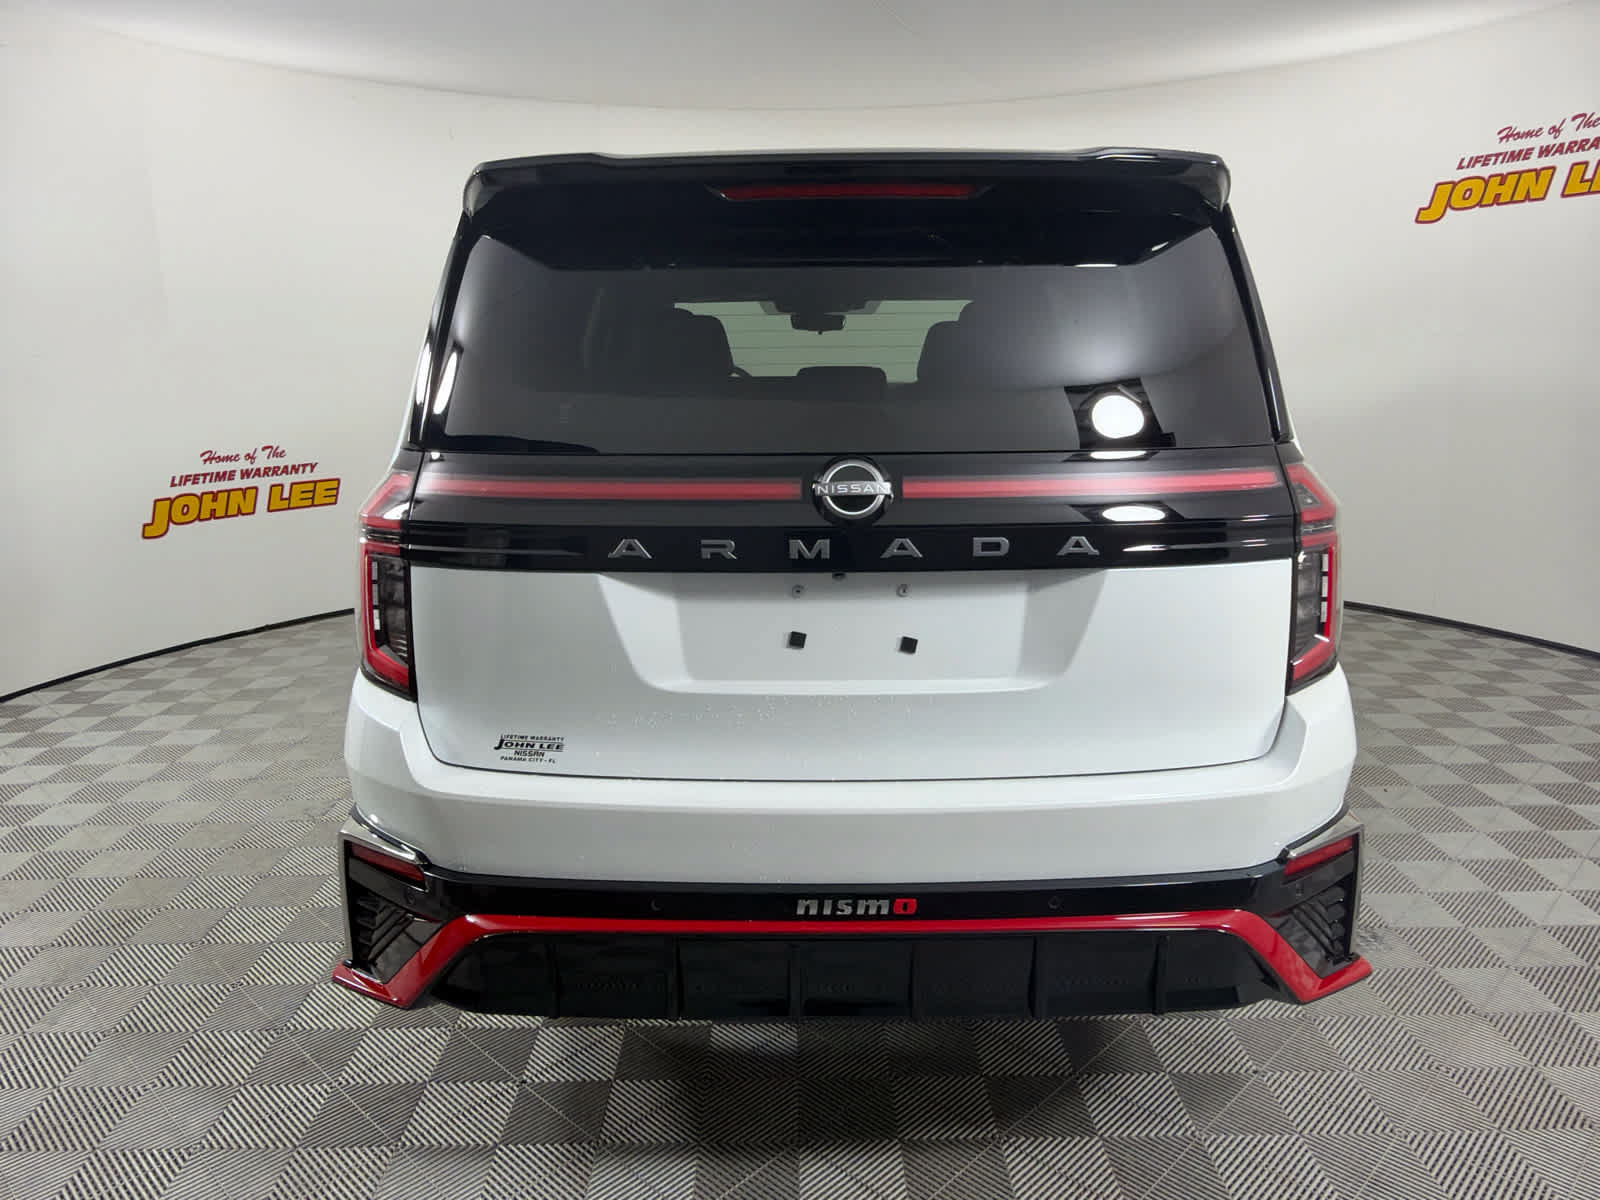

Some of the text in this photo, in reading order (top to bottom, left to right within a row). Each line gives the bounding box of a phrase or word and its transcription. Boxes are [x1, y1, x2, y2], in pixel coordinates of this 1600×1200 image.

[1497, 112, 1600, 144] Home of The
[1456, 147, 1535, 171] LIFETIME
[1415, 166, 1557, 224] JOHN
[200, 445, 287, 465] Home of The
[169, 462, 318, 488] LIFETIME WARRANTY
[817, 483, 891, 495] NISSAN
[142, 478, 340, 539] JOHN LEE
[607, 536, 1100, 560] ARMADA
[494, 738, 565, 751] JOHN LEE
[796, 898, 917, 916] nismo
